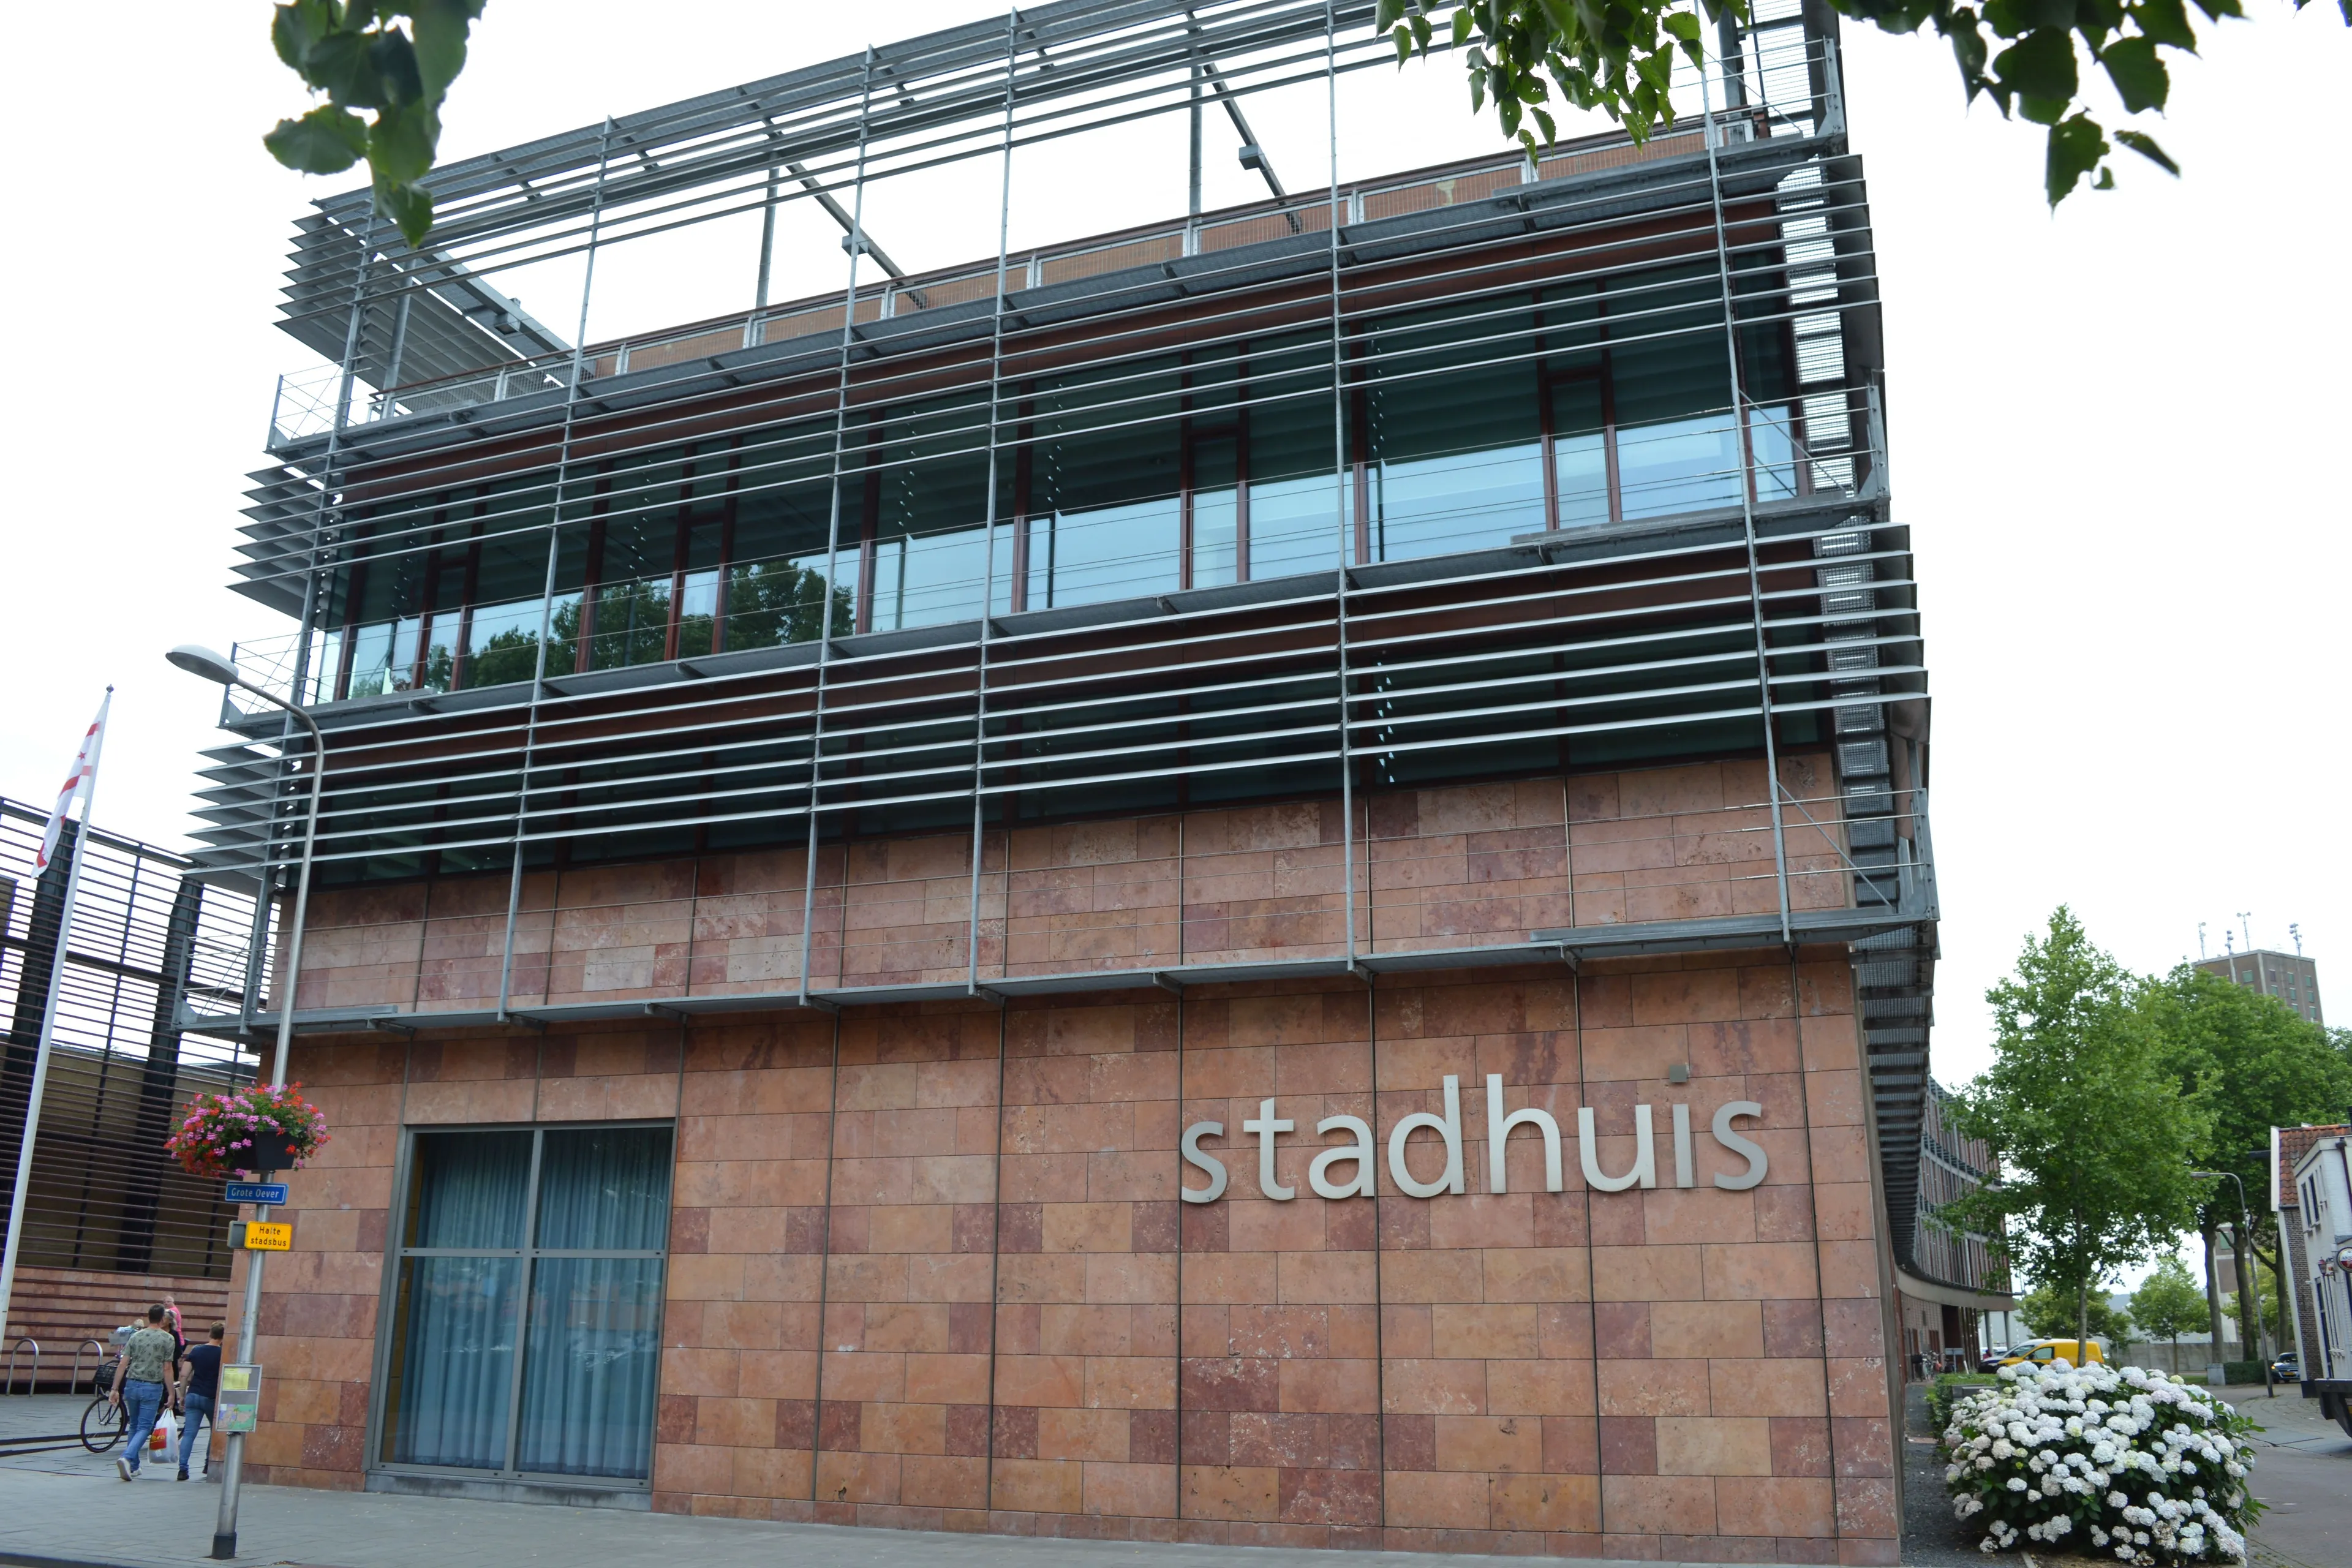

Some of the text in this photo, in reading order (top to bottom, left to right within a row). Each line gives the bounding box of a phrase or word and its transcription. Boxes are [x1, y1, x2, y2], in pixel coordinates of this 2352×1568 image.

[1181, 1065, 1768, 1203] stadhuis
[231, 1188, 279, 1198] Grote Oever
[259, 1226, 281, 1235] Halte
[251, 1237, 287, 1246] stadsbus
